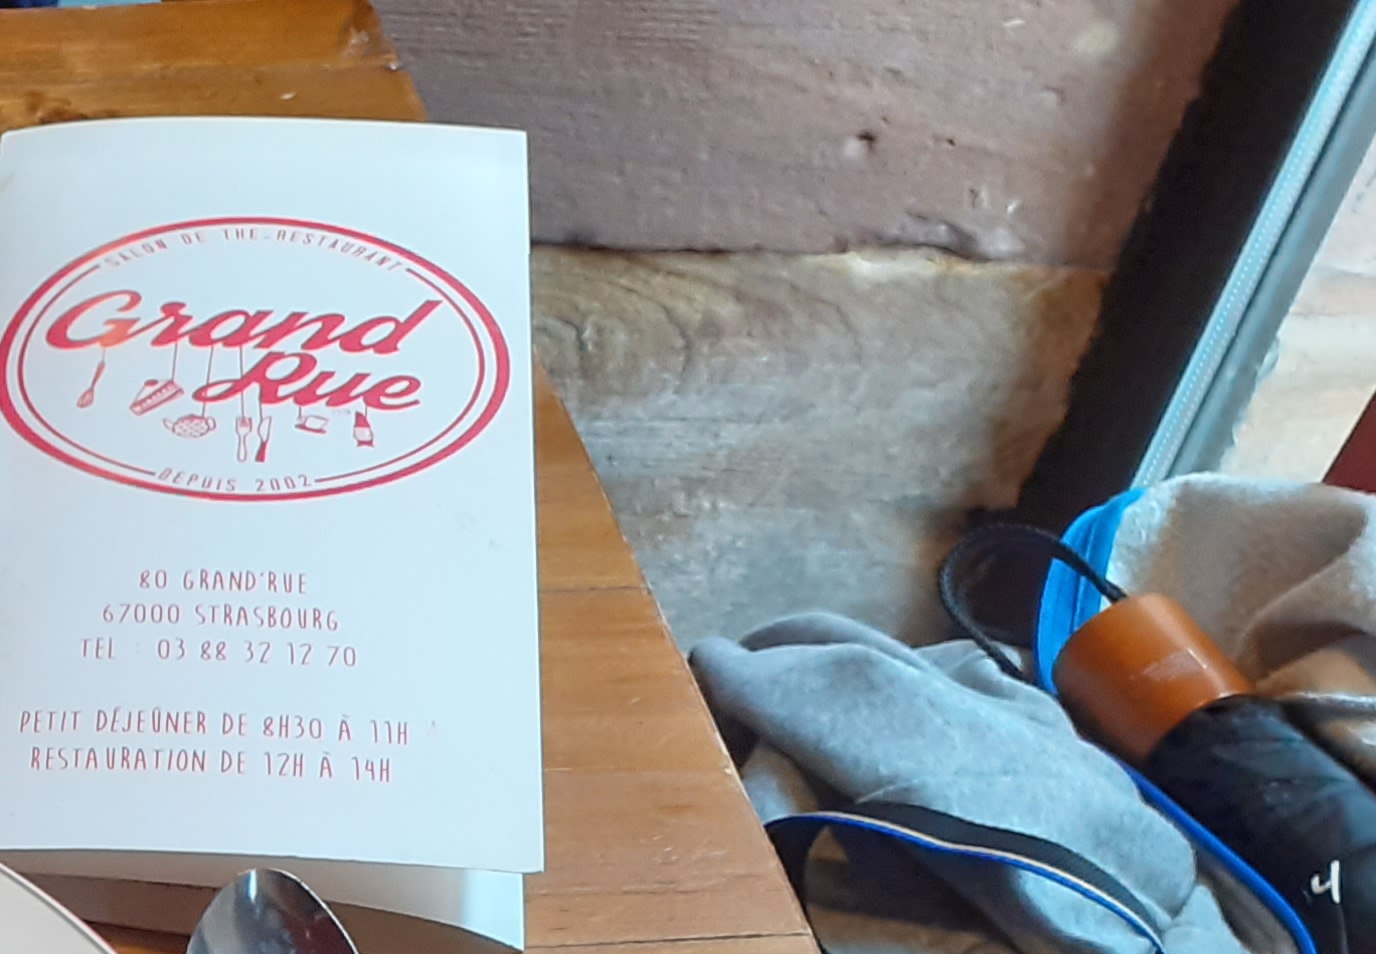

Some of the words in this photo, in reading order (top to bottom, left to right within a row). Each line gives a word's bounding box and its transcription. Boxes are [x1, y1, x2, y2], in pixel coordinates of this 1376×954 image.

[45, 290, 444, 354] Grand
[192, 351, 422, 409] Rue
[157, 467, 237, 492] DEPUIS
[255, 474, 311, 492] 2002
[139, 569, 168, 588] 80
[183, 569, 307, 594] GRAND'RUE
[102, 603, 180, 623] 67000
[195, 604, 339, 631] STRASBOURG
[82, 638, 115, 660] TEL
[157, 639, 186, 660] 03
[200, 641, 227, 661] 88
[244, 641, 272, 664] 32
[288, 643, 313, 665] 12
[328, 646, 357, 667] 70
[19, 710, 81, 735] PETIT
[222, 712, 247, 736] DE
[263, 715, 322, 740] 8H30
[370, 720, 408, 745] 11H
[30, 747, 206, 773] RESTAURATION
[220, 749, 247, 774] DE
[264, 753, 304, 778] 12H
[352, 757, 391, 783] 14H
